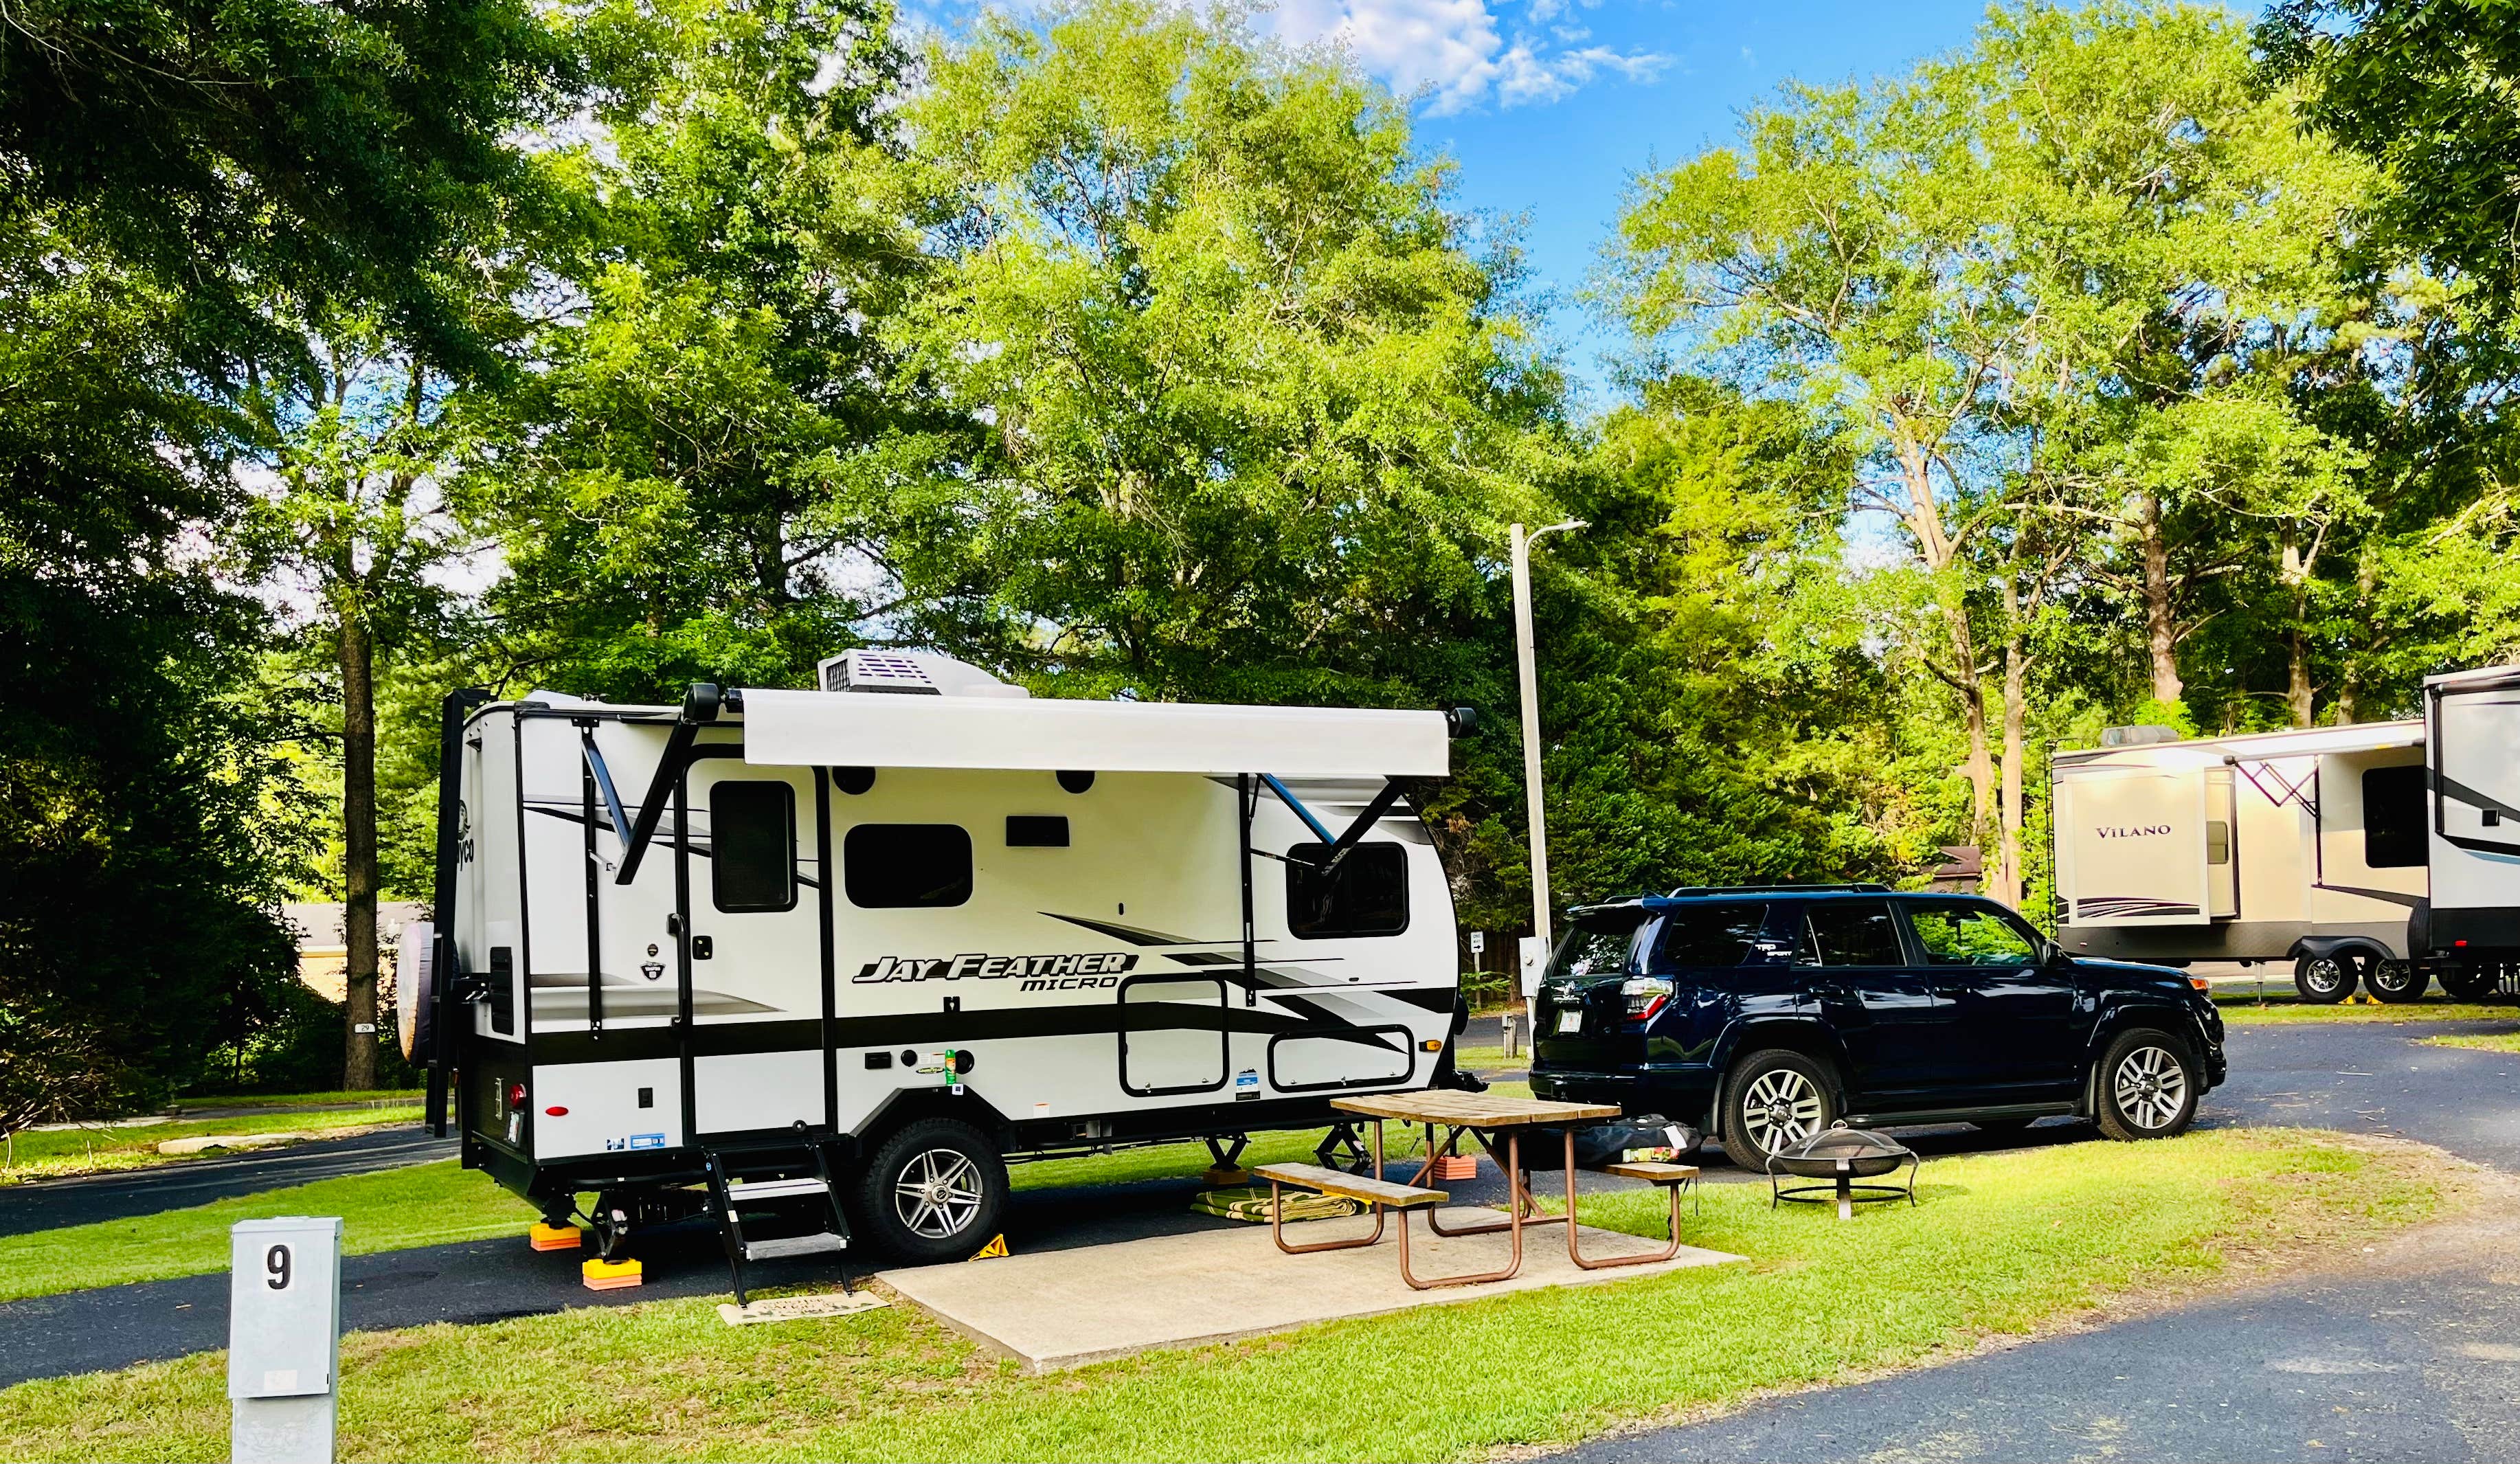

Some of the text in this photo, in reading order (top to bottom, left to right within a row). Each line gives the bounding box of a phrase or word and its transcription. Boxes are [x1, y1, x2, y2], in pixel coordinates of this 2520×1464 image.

[2095, 824, 2171, 839] VILANO
[457, 838, 474, 872] yco
[1755, 943, 1777, 951] TRD
[852, 953, 1128, 984] JAY FEATHER
[1020, 976, 1119, 992] MICRO
[267, 1244, 291, 1290] 9
